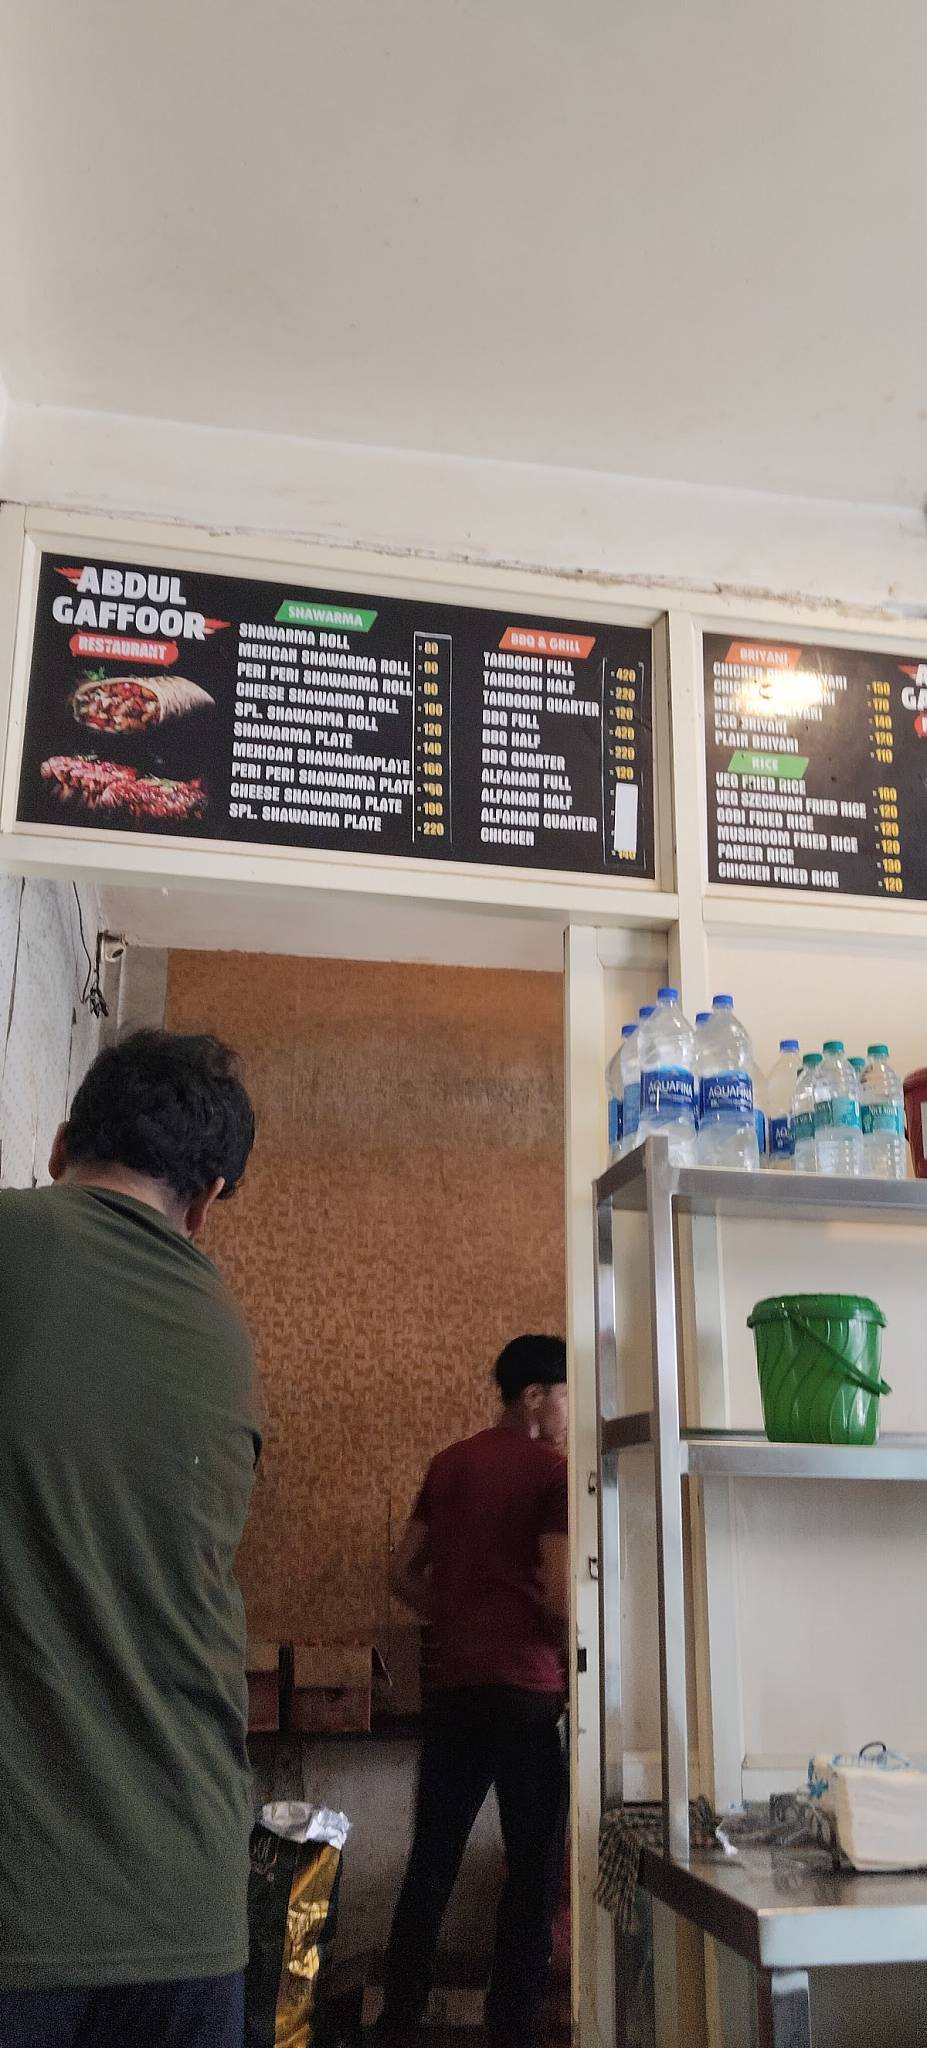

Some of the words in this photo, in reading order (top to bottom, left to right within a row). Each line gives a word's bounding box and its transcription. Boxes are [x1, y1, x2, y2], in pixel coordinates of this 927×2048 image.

[76, 566, 187, 606] ABDUL
[52, 595, 206, 641] GAFFOOR
[288, 606, 363, 627] SHAWARMA
[78, 636, 167, 660] RESTAURANT
[239, 622, 316, 646] SHAWARMA
[319, 632, 350, 650] ROLL
[511, 632, 535, 646] BBQ
[537, 636, 547, 649] &
[550, 637, 581, 653] GRILL
[238, 642, 298, 664] MEXICAN
[301, 650, 377, 673] SHAWARMA
[380, 659, 411, 677] ROLL
[483, 651, 543, 672] TANDOORI
[546, 659, 575, 677] FULL
[616, 667, 636, 683] 420
[740, 647, 788, 665] BRIYANI
[237, 662, 266, 679] PERI
[270, 665, 299, 683] PERI
[303, 670, 379, 693] SHAWARMA
[382, 678, 413, 697] ROLL
[483, 671, 543, 692] TANDOORI
[546, 678, 576, 696] HALF
[615, 686, 636, 702] 220
[236, 681, 285, 700] CHEESE
[288, 688, 364, 711] SHAWARMA
[368, 697, 399, 715] ROLL
[483, 690, 543, 711] TANDOORI
[546, 697, 600, 717] QUARTER
[615, 706, 634, 721] 120
[234, 701, 263, 719] SPL.
[267, 705, 343, 728] SHAWARMA
[347, 714, 378, 732] ROLL
[423, 722, 442, 737] 120
[482, 709, 508, 727] BBQ
[511, 712, 540, 730] FULL
[614, 725, 635, 741] 420
[874, 714, 892, 730] 140
[232, 741, 293, 763] MEXICAN
[233, 721, 312, 745] SHAWARMA
[315, 731, 353, 749] PLATE
[422, 742, 442, 756] 140
[482, 728, 507, 746] BBQ
[511, 732, 541, 749] HALF
[615, 745, 635, 761] 220
[715, 729, 748, 747] PLAIN
[752, 735, 799, 753] BRIYANI
[231, 762, 261, 779] PERI
[266, 765, 295, 783] PERI
[299, 769, 376, 792] SHAWARMA
[482, 748, 507, 766] BBQ
[510, 751, 566, 772] QUARTER
[615, 766, 634, 780] 120
[752, 755, 778, 770] RICE
[481, 767, 539, 788] ALFAHAM
[543, 774, 572, 791] FULL
[716, 771, 739, 789] VEG
[742, 774, 776, 793] FRIED
[779, 777, 806, 795] RICE
[230, 782, 280, 801] CHEESE
[283, 787, 361, 810] SHAWARMA
[365, 796, 402, 814] PLATE
[481, 787, 540, 808] ALFAHAM
[543, 793, 573, 811] HALF
[716, 789, 739, 806] VEG
[741, 792, 803, 812] SZECHWAN
[805, 797, 838, 816] FRIED
[840, 800, 867, 820] RICE
[878, 804, 898, 819] 120
[229, 803, 258, 820] SPL.
[262, 806, 340, 828] SHAWARMA
[344, 814, 382, 832] PLATE
[423, 822, 445, 836] 220
[481, 807, 540, 827] ALFAHAM
[543, 813, 598, 833] QUARTER
[716, 807, 745, 825] GOBI
[749, 810, 783, 828] FRIED
[786, 813, 814, 831] RICE
[880, 821, 899, 837] 120
[480, 826, 535, 847] CHICKEN
[717, 824, 790, 847] MUSHROOM
[793, 832, 827, 851] FRIED
[830, 835, 858, 853] RICE
[881, 839, 901, 855] 120
[718, 843, 764, 862] PANEER
[767, 847, 794, 865] RICE
[718, 861, 770, 882] CHICKEN
[773, 866, 808, 885] FRIED
[811, 869, 840, 888] RICE
[883, 877, 903, 893] 120
[648, 1080, 693, 1098] AQUAFINA
[709, 1084, 752, 1100] AQUAFINA
